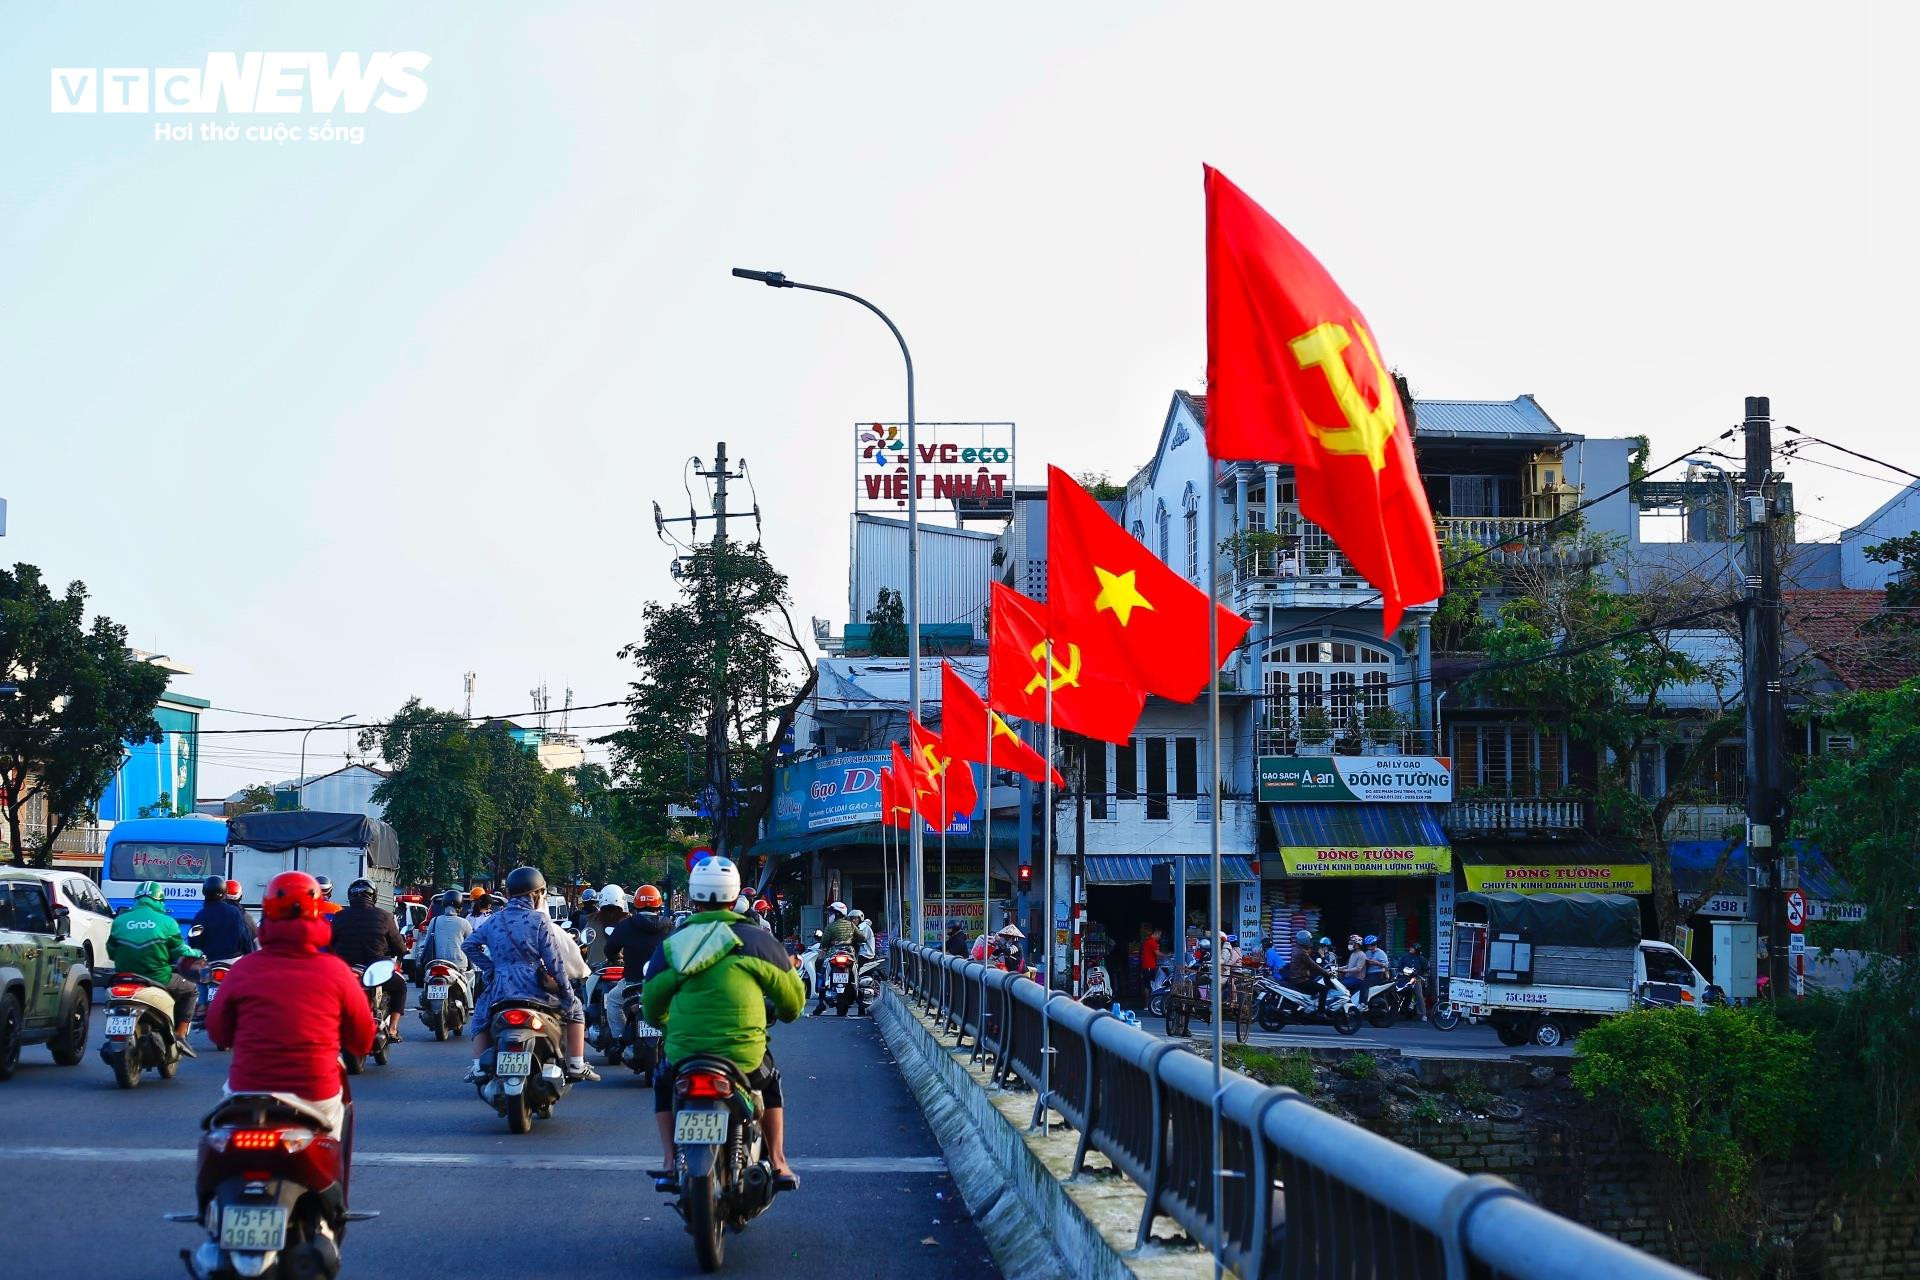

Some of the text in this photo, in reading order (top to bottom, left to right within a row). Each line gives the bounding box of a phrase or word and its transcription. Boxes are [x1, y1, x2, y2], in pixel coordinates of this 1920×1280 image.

[961, 447, 1009, 464] eco
[933, 466, 1007, 507] NHẬT
[1376, 760, 1421, 770] ĐẠI LÝ GẠO
[1262, 772, 1300, 781] GẠO SẠCH
[1348, 771, 1449, 787] ĐÔNG TƯỜNG
[810, 780, 837, 802] Gạo
[1296, 861, 1330, 871] CHUYÊN
[1331, 863, 1352, 871] KINH
[1354, 863, 1383, 871] DOANH
[1504, 866, 1612, 879] ĐÔNG TƯỜNG
[1481, 880, 1518, 889] CHUYÊN
[1520, 881, 1543, 889] KINH
[1545, 881, 1577, 889] DOANH
[1711, 900, 1738, 912] 398
[126, 919, 156, 930] Grab
[502, 1053, 526, 1064] 75-F1
[498, 1063, 529, 1074] 970.78
[684, 1112, 719, 1127] 75-E1
[677, 1127, 722, 1142] 393.41
[233, 1208, 276, 1227] 75-F1
[225, 1228, 281, 1248] 396.30
